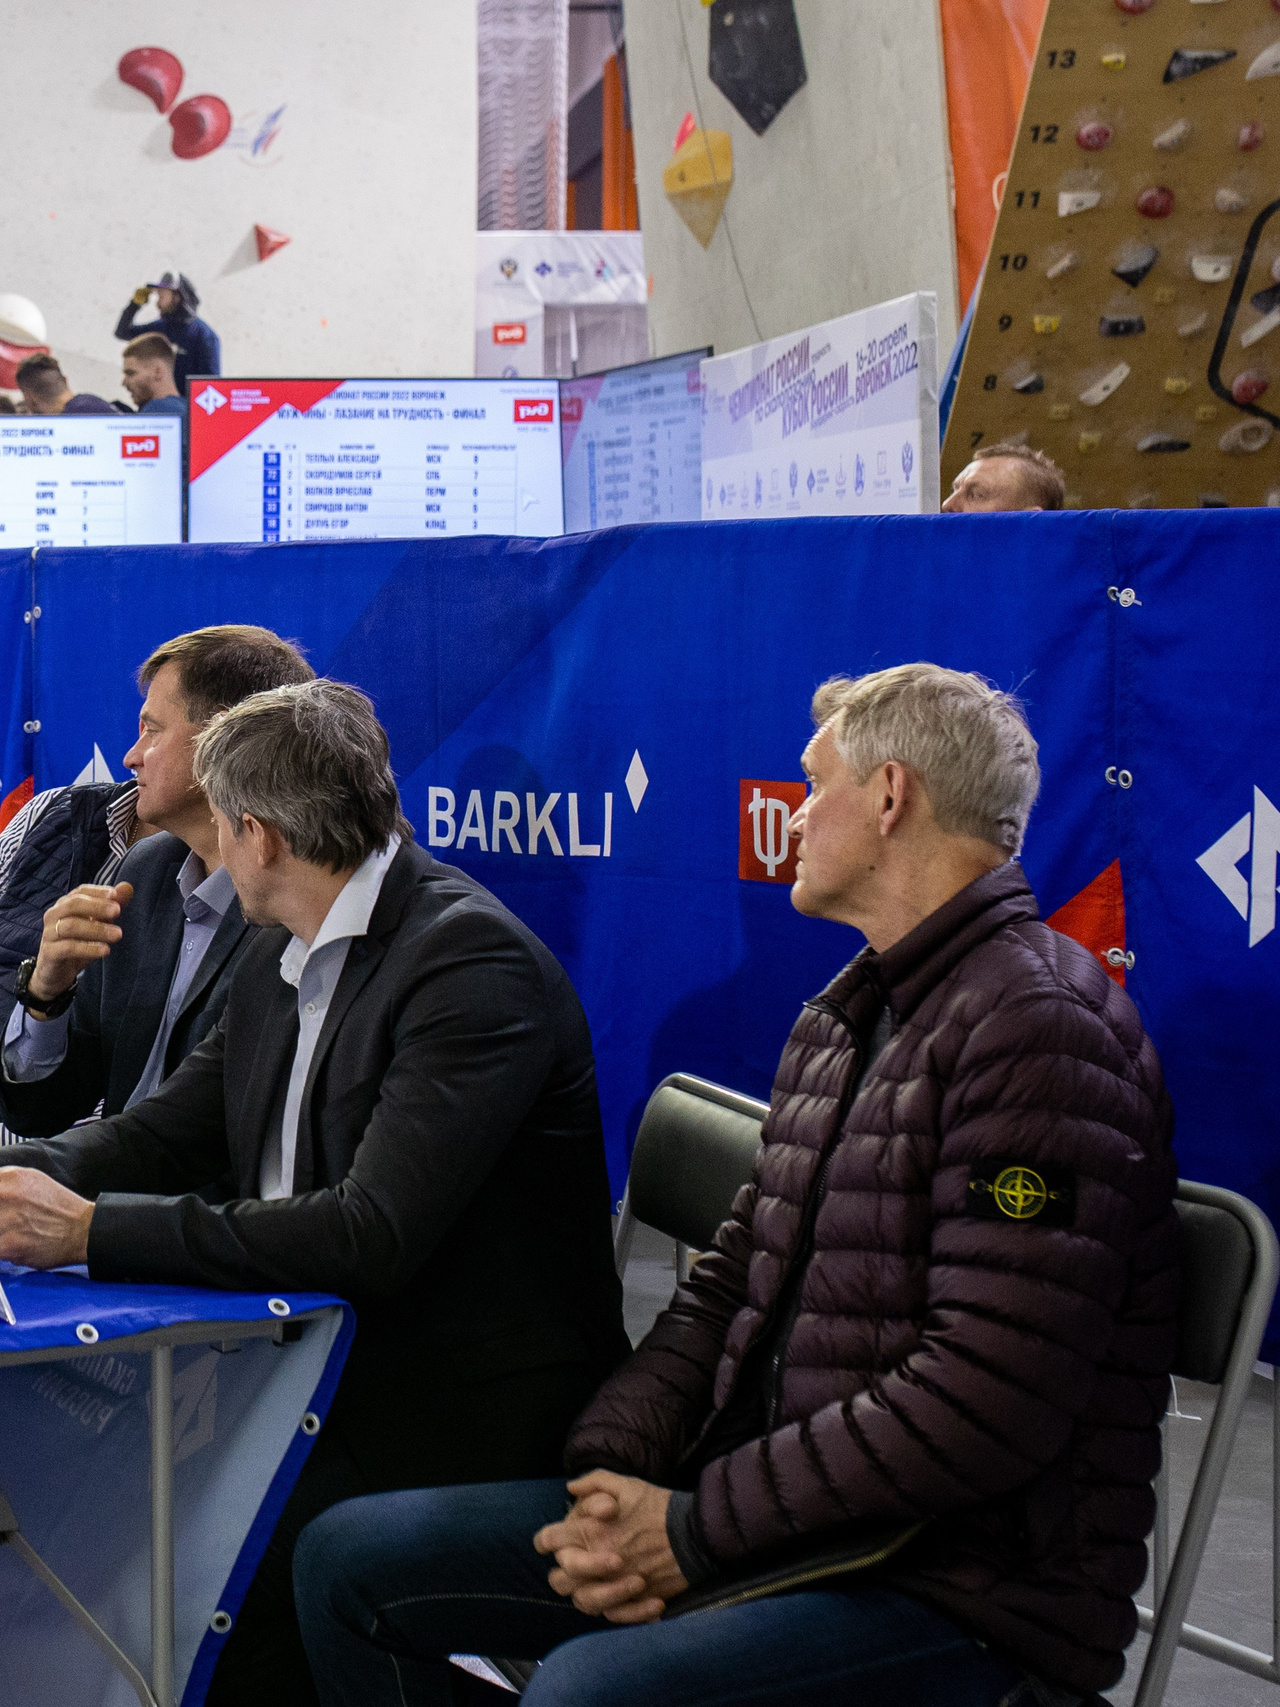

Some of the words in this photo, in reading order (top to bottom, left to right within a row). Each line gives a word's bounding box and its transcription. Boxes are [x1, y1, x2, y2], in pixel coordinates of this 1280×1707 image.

[1046, 50, 1076, 69] 13
[1029, 125, 1059, 144] 12
[1014, 191, 1041, 210] 11
[999, 254, 1028, 271] 10
[998, 315, 1012, 331] 9
[856, 337, 877, 373] 16-20
[879, 322, 908, 360] апреля
[776, 335, 810, 392] РОССИИ
[855, 352, 892, 404] ВОРОНЕЖ
[893, 341, 918, 380] 2022
[811, 361, 849, 418] РОССИИ
[983, 375, 997, 391] 8
[412, 390, 446, 400] ВОРОНЕЖ
[333, 407, 375, 420] ЛАЗАНИЕ
[377, 407, 390, 420] НА
[392, 407, 444, 421] ТРУДНОСТЬ
[451, 407, 486, 420] ФИНАЛ
[20, 428, 55, 438] ВОРОНЕЖ
[970, 431, 984, 448] 7
[3, 445, 53, 458] ТРУДНОСТЬ
[62, 444, 95, 456] ФИНАЛ
[337, 453, 380, 464] АЛЕКСАНДР
[355, 469, 382, 480] СЕРГЕЙ
[305, 486, 333, 496] ВОЛКОВ
[335, 486, 372, 496] ВЯЧЕСЛАВ
[305, 502, 342, 512] СВИРИДОВ
[345, 502, 368, 512] АНТОН
[331, 519, 349, 529] ЕГОР
[427, 785, 614, 857] BARKLI
